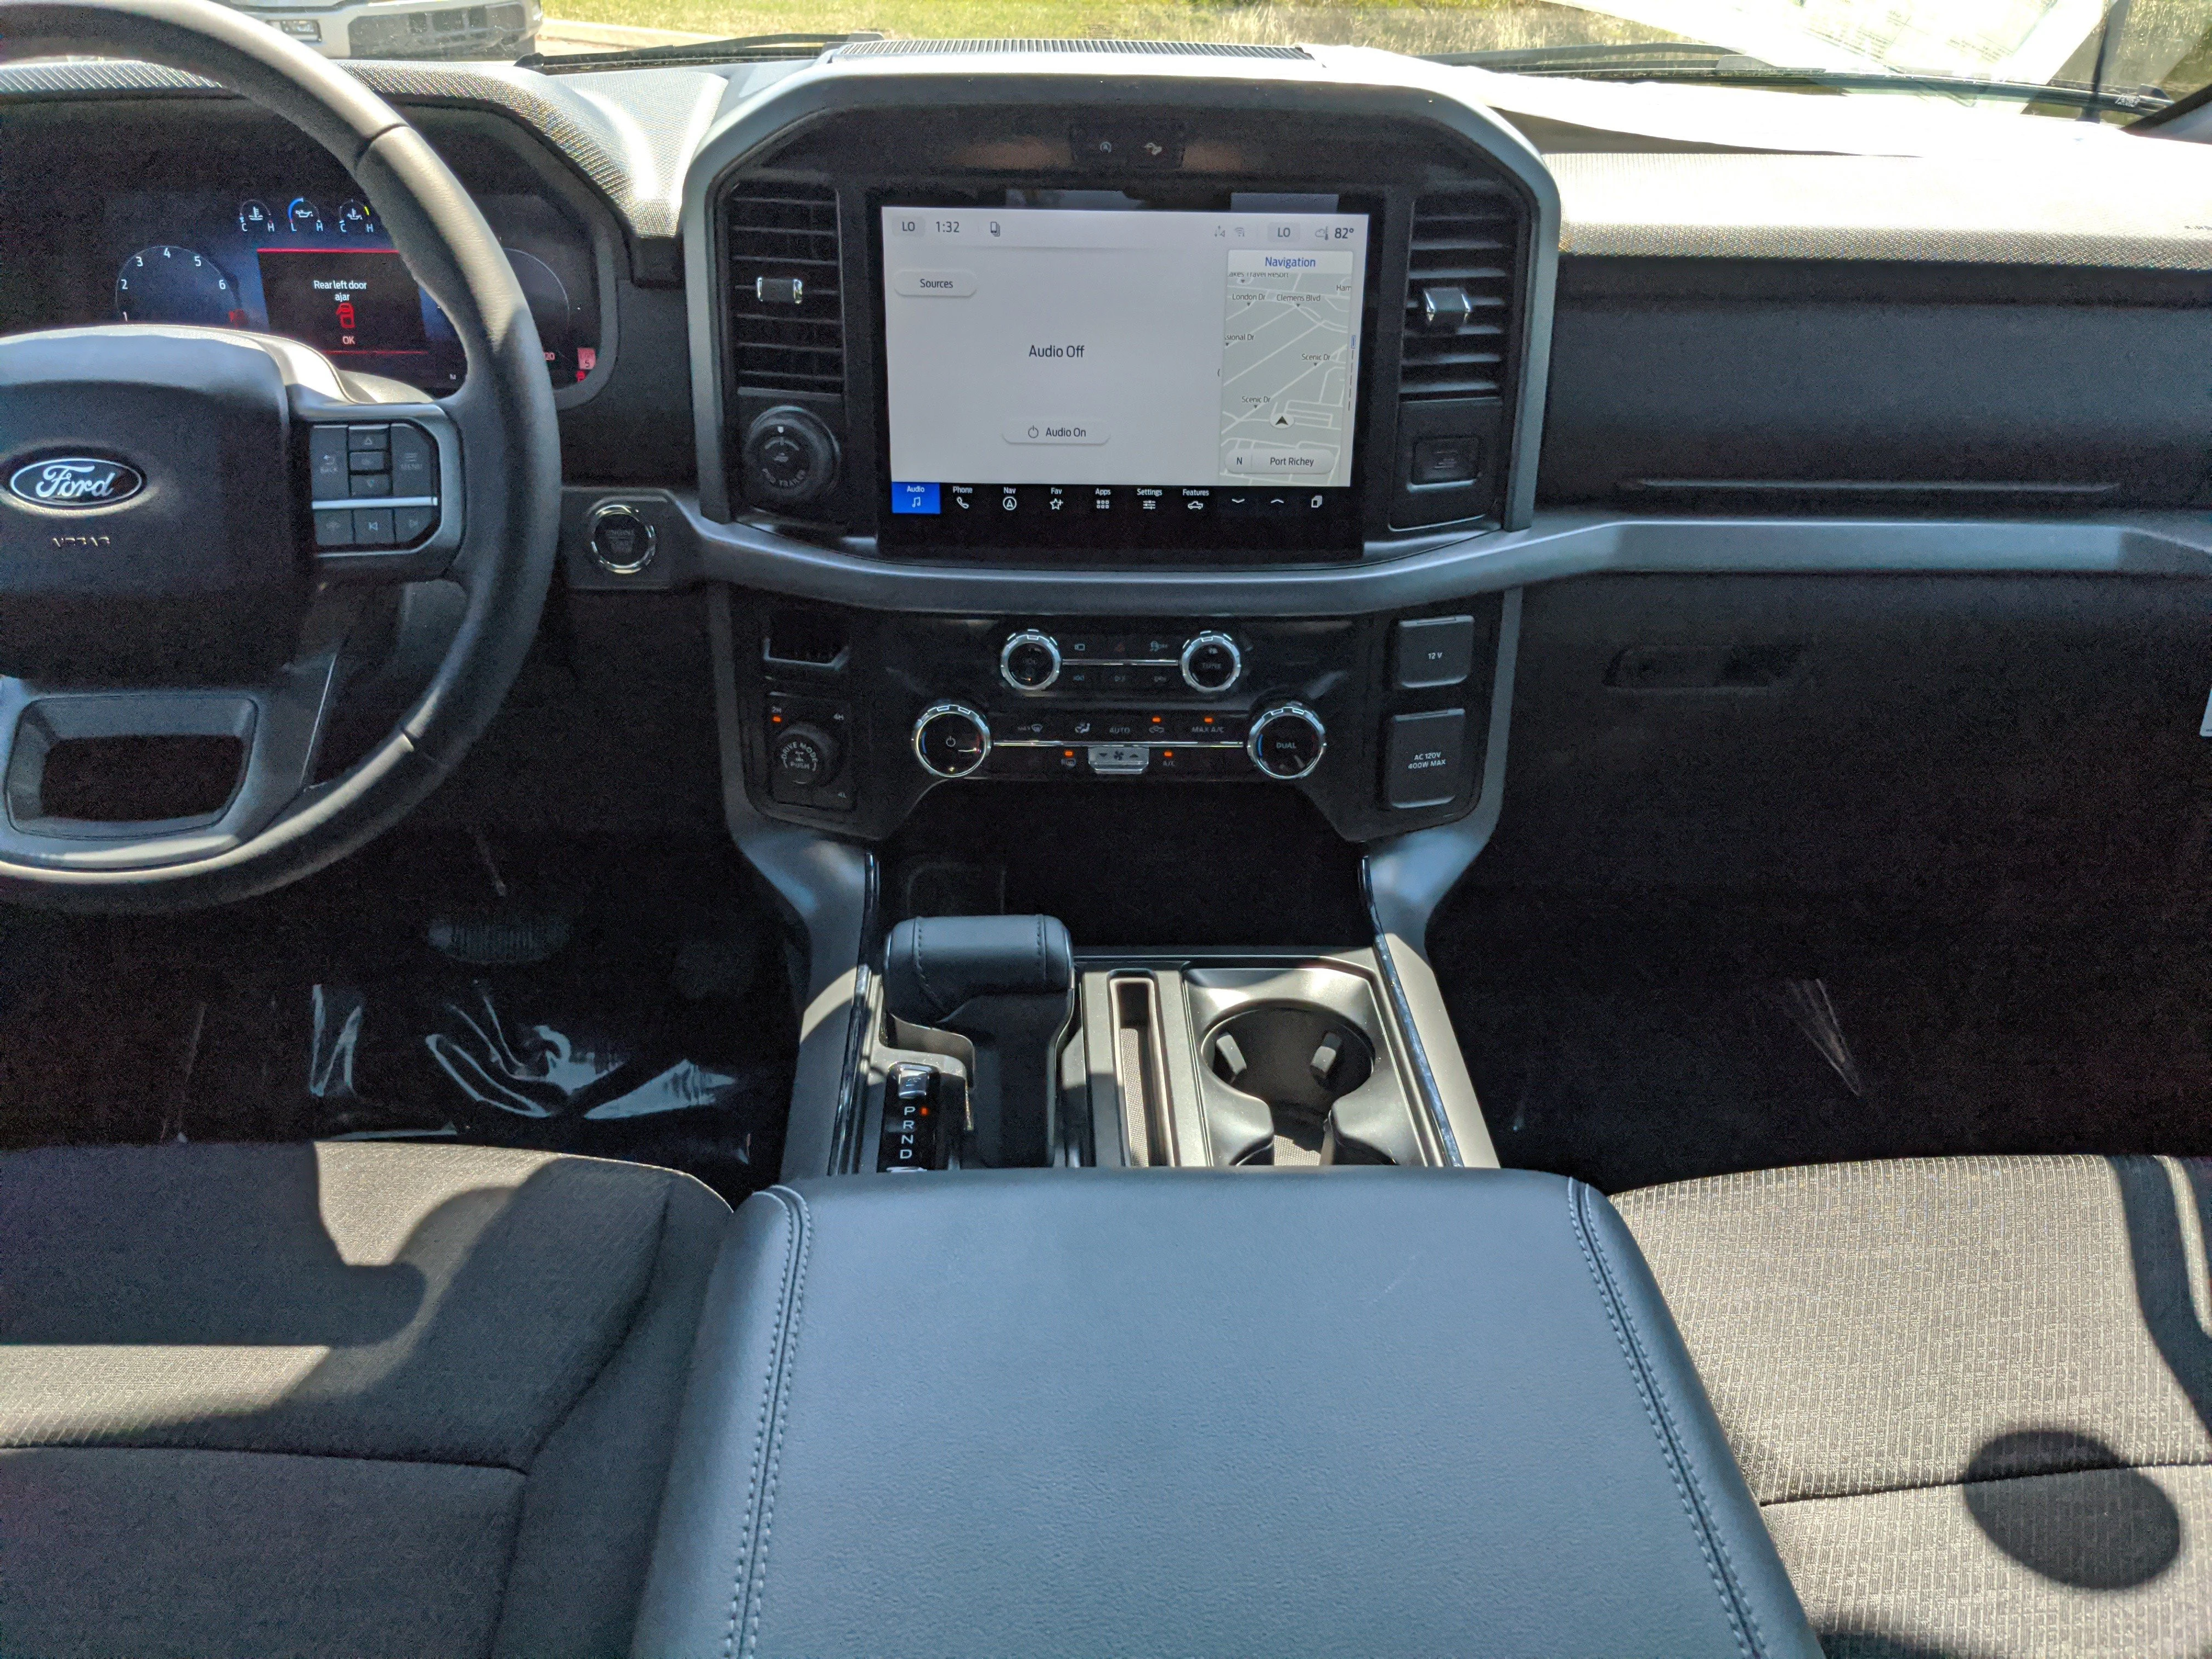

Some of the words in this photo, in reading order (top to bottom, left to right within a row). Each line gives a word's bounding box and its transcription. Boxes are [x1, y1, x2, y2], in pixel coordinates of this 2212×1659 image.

[241, 223, 247, 232] C
[267, 223, 274, 232] H
[291, 223, 297, 232] L
[316, 222, 324, 232] H
[340, 223, 347, 232] C
[366, 223, 374, 233] H
[901, 221, 915, 232] LO
[936, 221, 960, 233] 1:32
[1277, 227, 1291, 238] LO
[1334, 228, 1355, 239] 82°
[163, 247, 171, 258] 4
[136, 256, 143, 267] 3
[194, 256, 201, 267] 5
[1265, 257, 1316, 268] Navigation
[121, 279, 128, 290] 2
[219, 279, 226, 290] 6
[313, 280, 332, 289] Rear
[333, 280, 347, 289] left
[348, 280, 367, 290] door
[920, 279, 953, 288] Sources
[335, 292, 350, 302] ajar
[342, 336, 355, 345] OK
[1029, 345, 1063, 357] Audio
[1066, 345, 1085, 358] Off
[1046, 427, 1071, 437] Audio
[1073, 428, 1086, 437] On
[1237, 457, 1243, 465] N
[1270, 458, 1286, 466] Port
[1289, 458, 1314, 467] Richey
[36, 465, 116, 498] Ford
[799, 742, 818, 763] MODE
[1408, 760, 1429, 769] 400W
[904, 1106, 916, 1116] P
[903, 1120, 915, 1129] R
[901, 1135, 913, 1144] N
[900, 1149, 912, 1159] D
